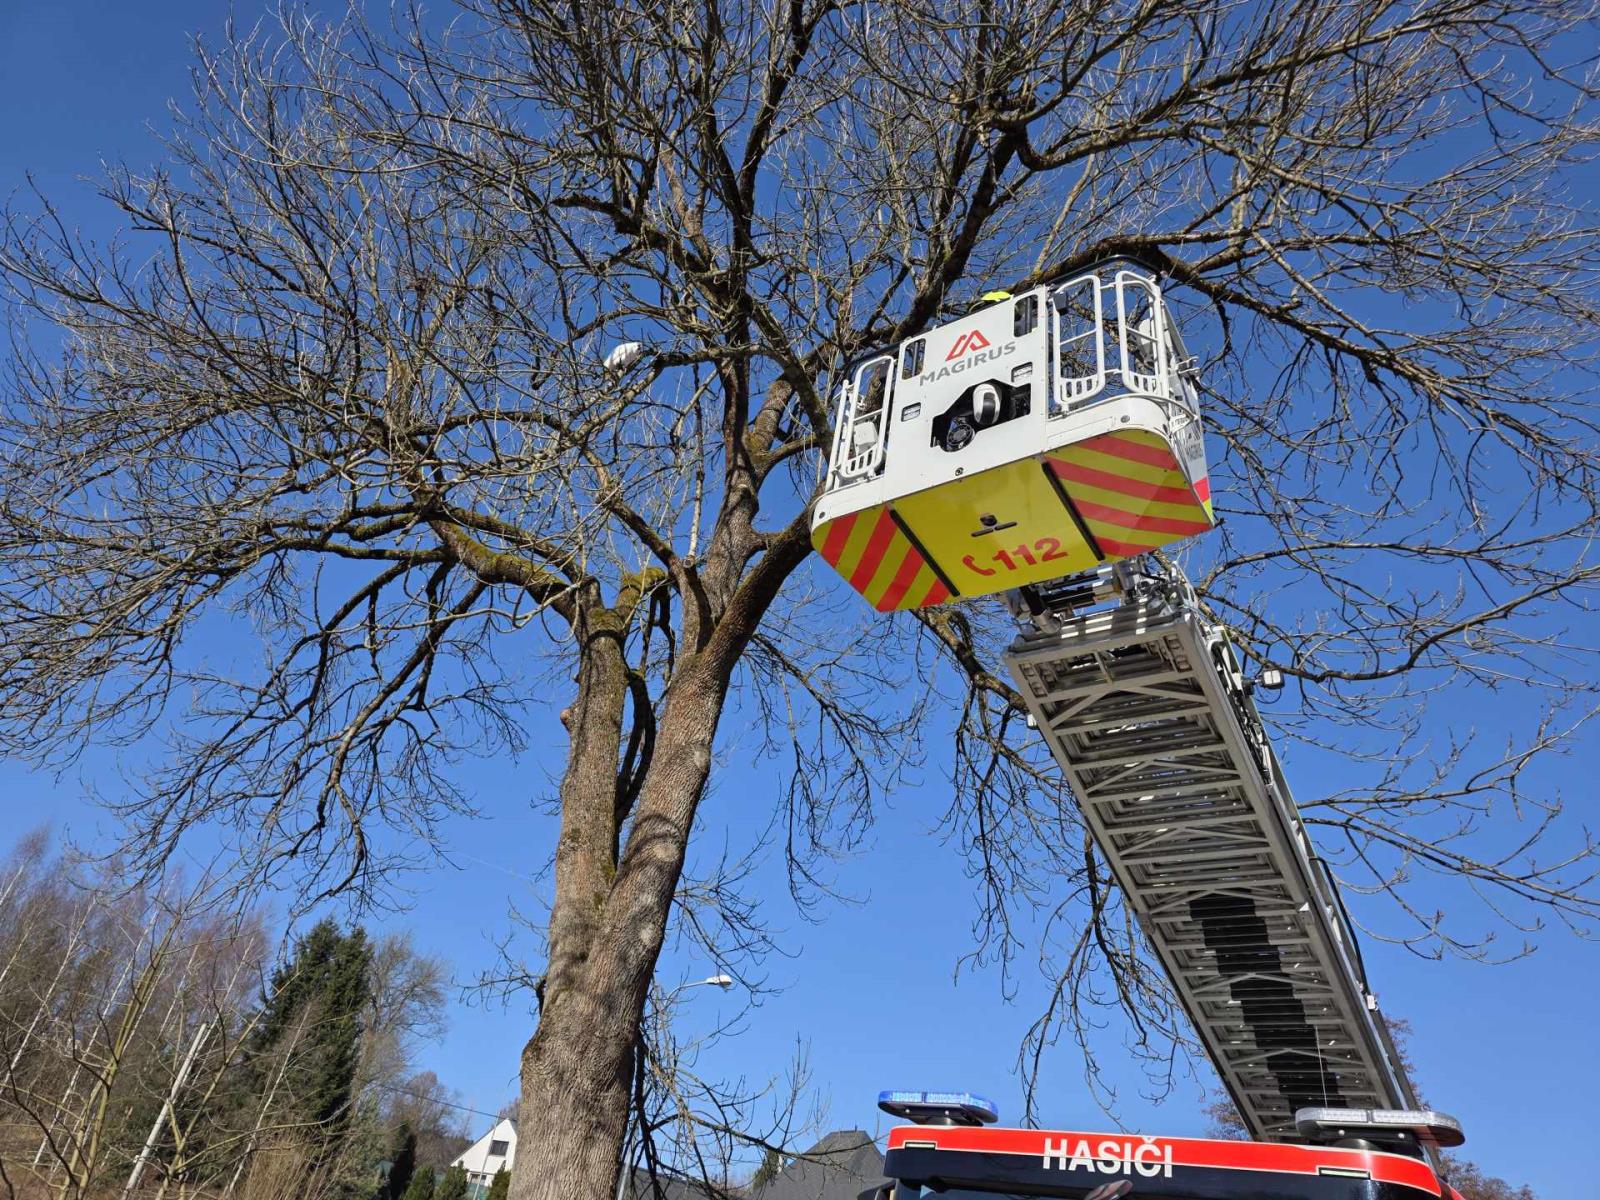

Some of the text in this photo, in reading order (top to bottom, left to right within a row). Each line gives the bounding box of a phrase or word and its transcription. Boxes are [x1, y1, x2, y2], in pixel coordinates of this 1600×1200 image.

[920, 341, 1016, 386] MAGIRUS
[992, 538, 1068, 571] 112
[1043, 1136, 1172, 1178] HASIČI
